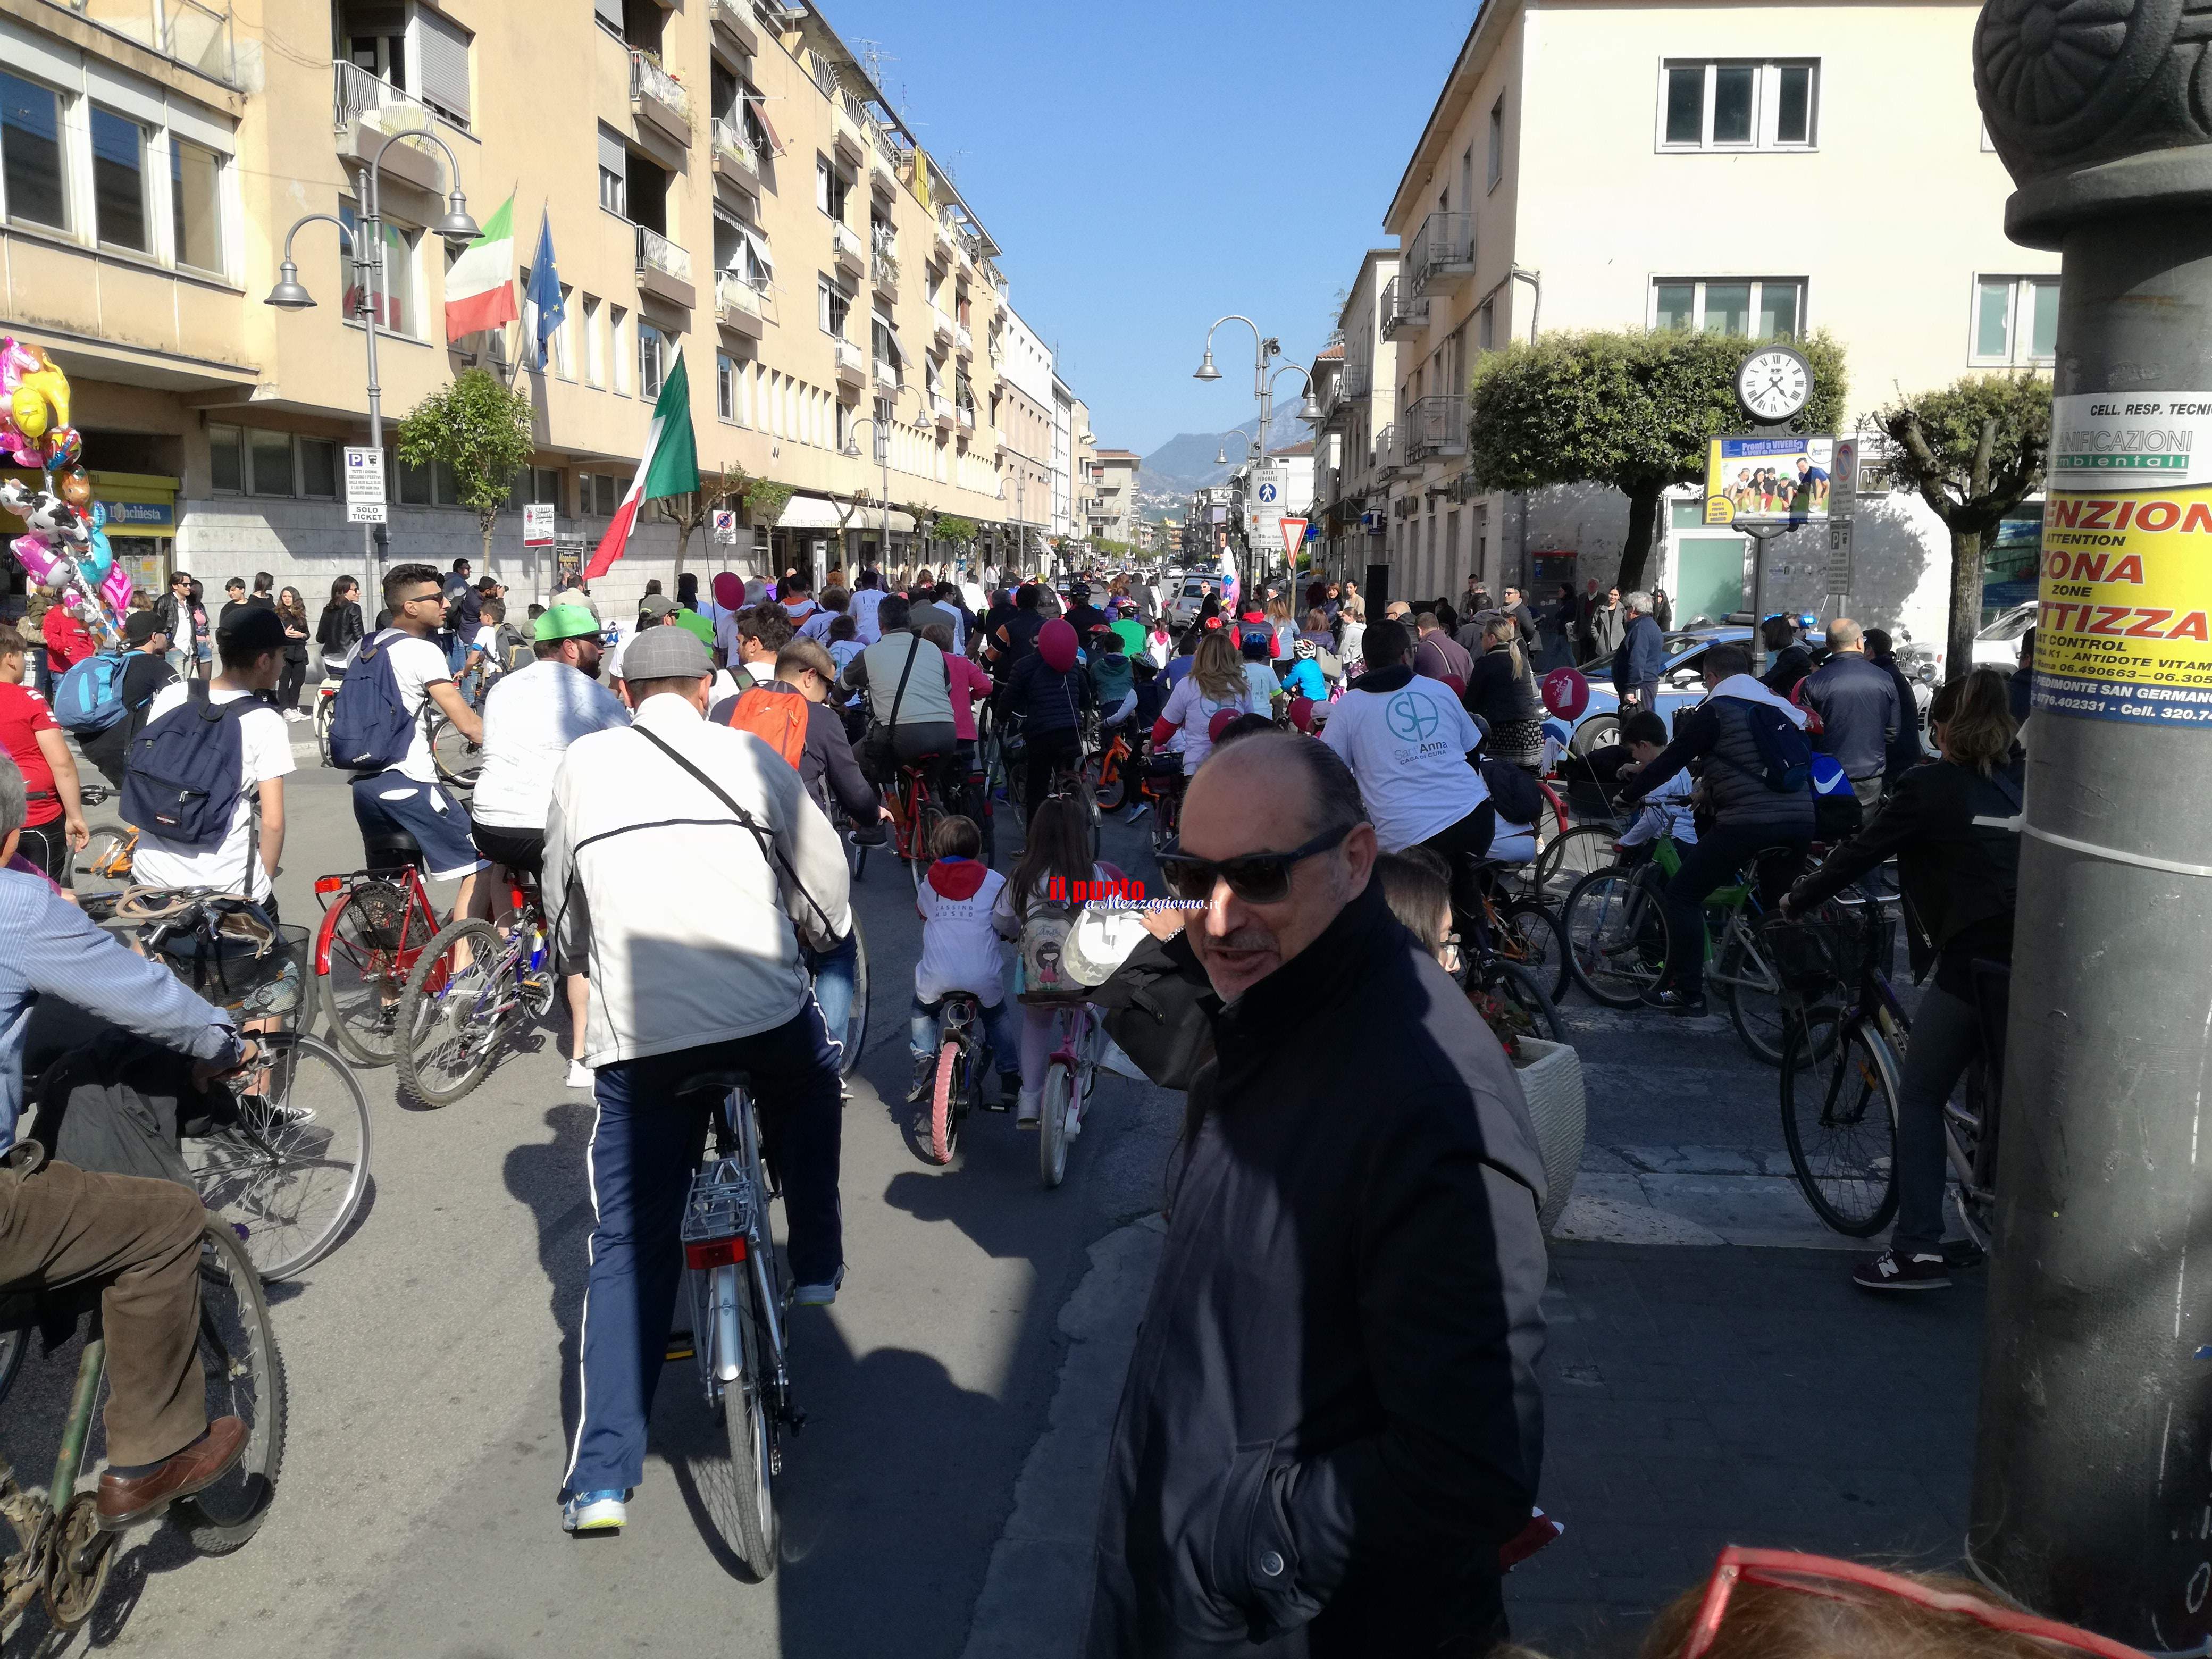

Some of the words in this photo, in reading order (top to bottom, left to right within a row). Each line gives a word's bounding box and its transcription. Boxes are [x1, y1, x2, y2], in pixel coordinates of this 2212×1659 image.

[2091, 404, 2121, 416] CELL.
[2125, 404, 2163, 415] RESP.
[2169, 404, 2212, 415] TECNI
[1742, 442, 1765, 451] Pronti
[351, 454, 362, 466] P
[2055, 456, 2185, 467] mbientali
[2046, 533, 2126, 546] ATTENTION
[2052, 585, 2092, 597] ZONE
[2049, 635, 2127, 652] CONTROL
[2049, 649, 2061, 658] K1
[2072, 652, 2153, 667] ANTIDOTE
[2101, 685, 2133, 697] SAN
[2137, 688, 2212, 703] GERMAN
[2121, 704, 2155, 717] Cell.
[1394, 741, 1448, 760] Sant'Anna
[1400, 756, 1419, 765] CASA
